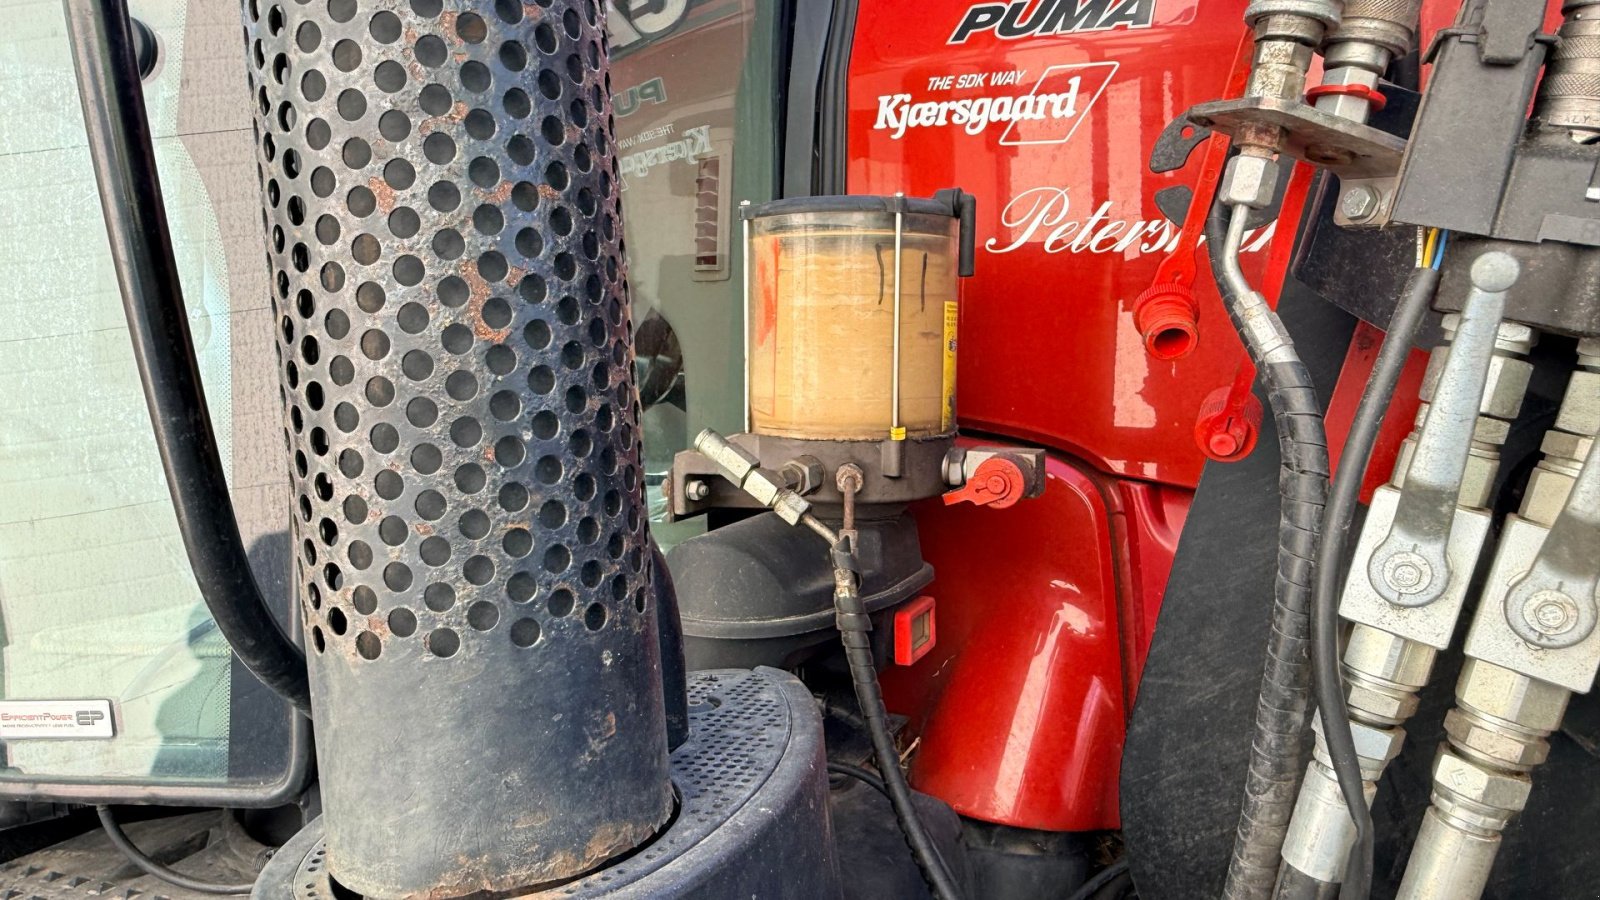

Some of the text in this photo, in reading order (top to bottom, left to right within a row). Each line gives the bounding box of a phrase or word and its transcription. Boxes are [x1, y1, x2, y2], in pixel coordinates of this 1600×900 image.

[946, 0, 1156, 45] PUMA
[927, 70, 1027, 91] THE SDK WAY
[873, 76, 1082, 139] Kjærsgaard
[76, 710, 105, 726] EP
